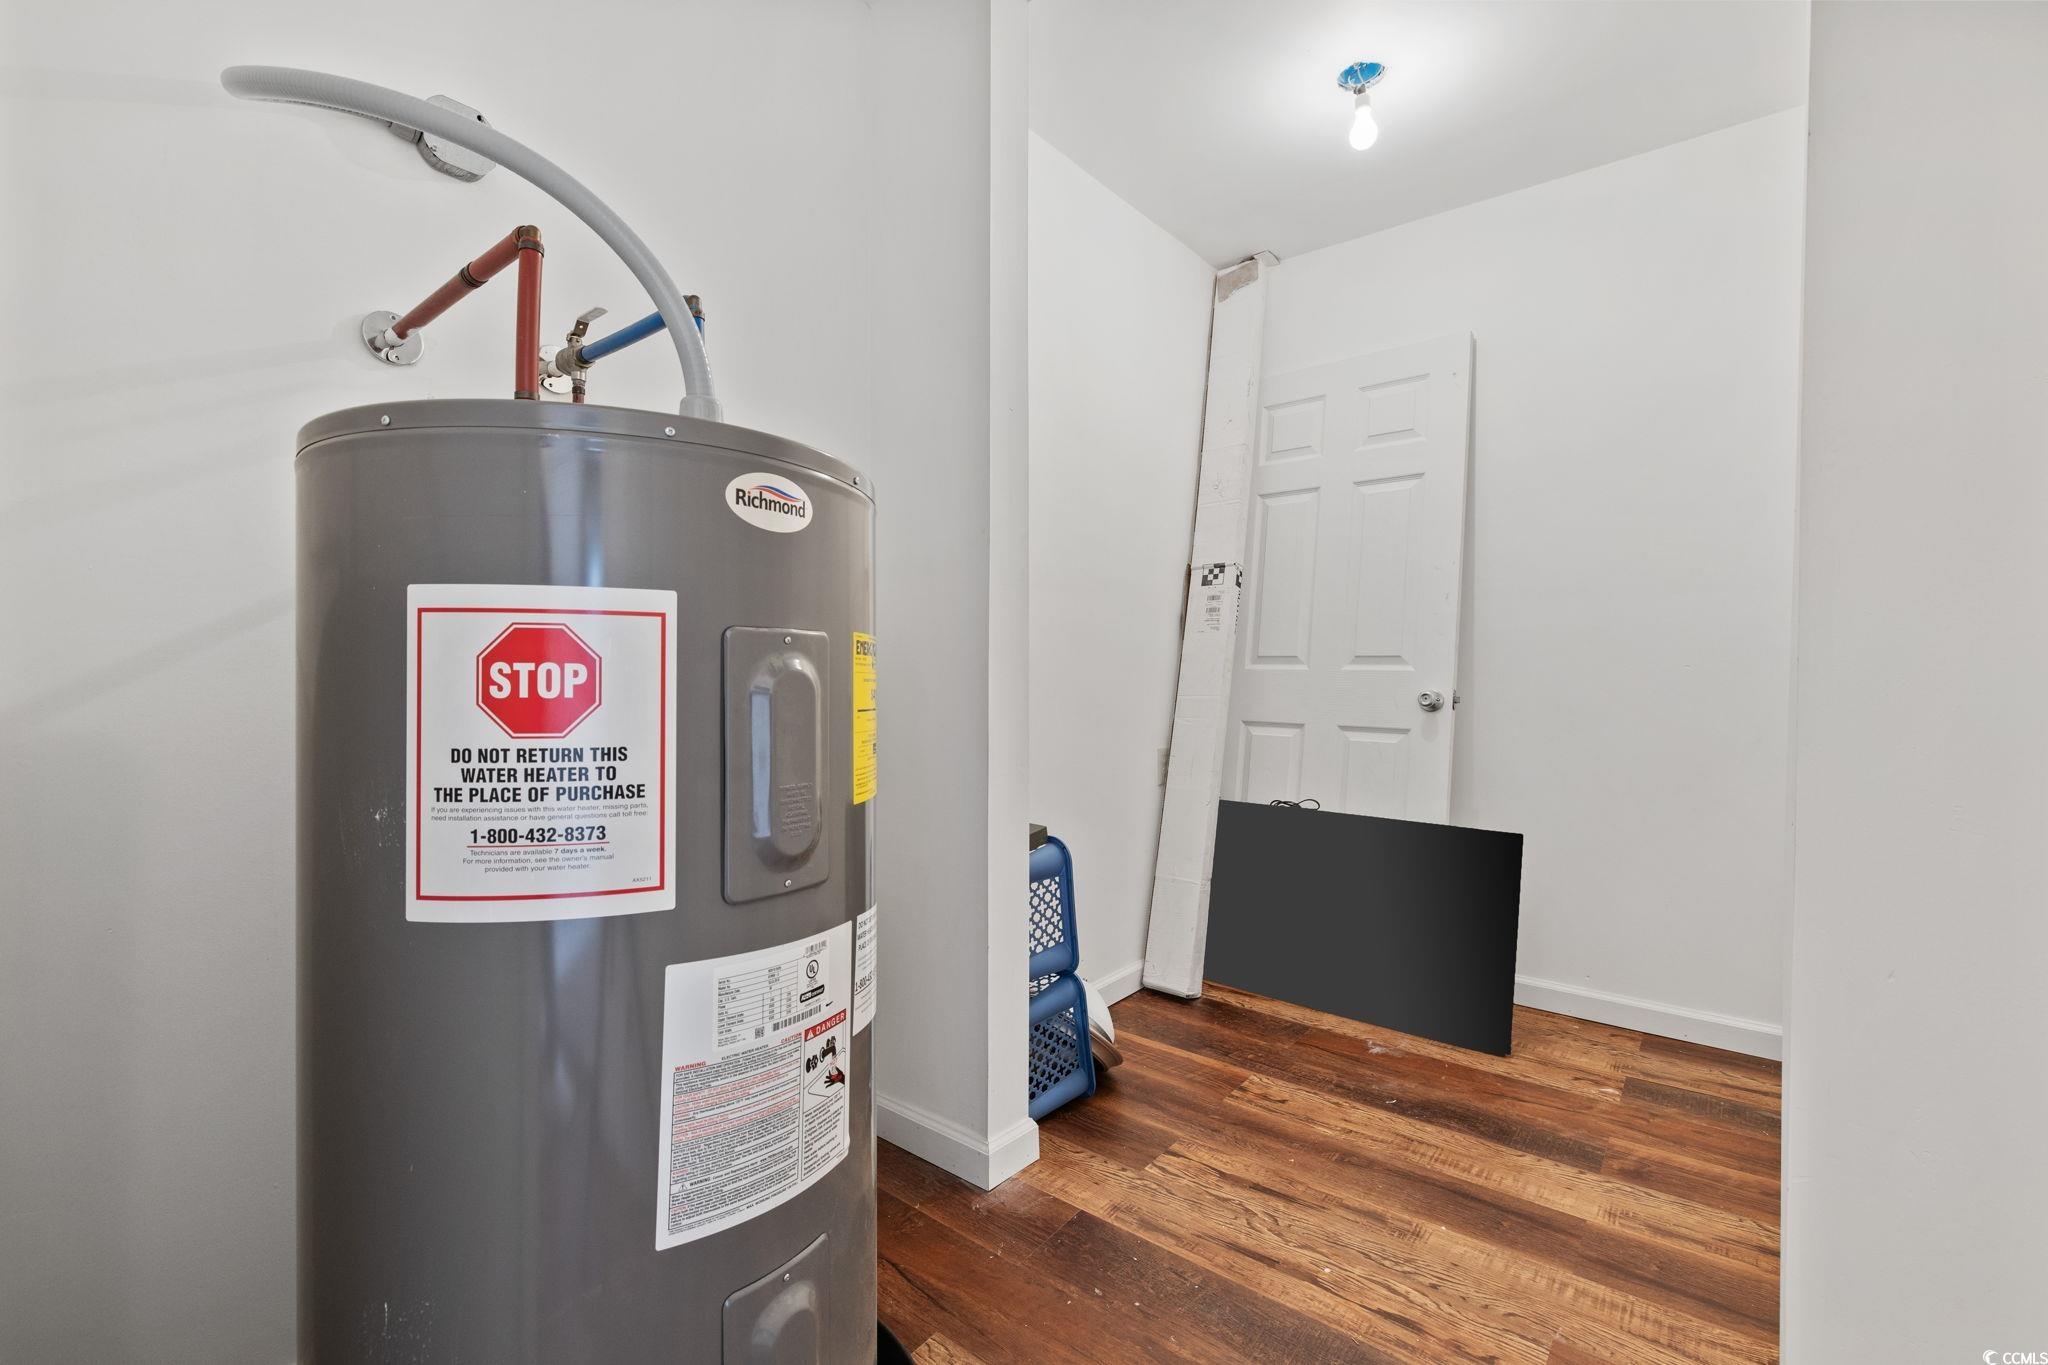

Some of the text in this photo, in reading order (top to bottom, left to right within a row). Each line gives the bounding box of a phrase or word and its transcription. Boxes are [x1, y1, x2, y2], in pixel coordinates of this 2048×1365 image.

[735, 488, 806, 519] Richmond
[489, 661, 588, 699] STOP
[451, 746, 629, 764] DO NOT RETURN THIS
[461, 766, 616, 783] WATER HEATER TO
[434, 784, 646, 803] THE PLACE OF PURCHASE
[436, 807, 448, 815] you
[461, 806, 502, 815] experiencing
[602, 803, 629, 811] missing
[630, 802, 649, 811] parts,
[547, 813, 573, 822] general
[574, 812, 608, 821] questions
[622, 810, 633, 818] toll
[470, 825, 606, 844] 1-800-432-8373
[469, 849, 509, 857] Technicians
[522, 848, 553, 856] available
[560, 847, 578, 856] days
[493, 857, 533, 865] information,
[561, 854, 588, 862] owner's
[589, 853, 615, 861] manual
[484, 865, 514, 873] provided
[530, 865, 545, 873] your
[568, 863, 591, 871] heater.
[816, 1012, 845, 1033] DANGER
[780, 1032, 801, 1043] CAUTION
[674, 1061, 707, 1072] WARNING
